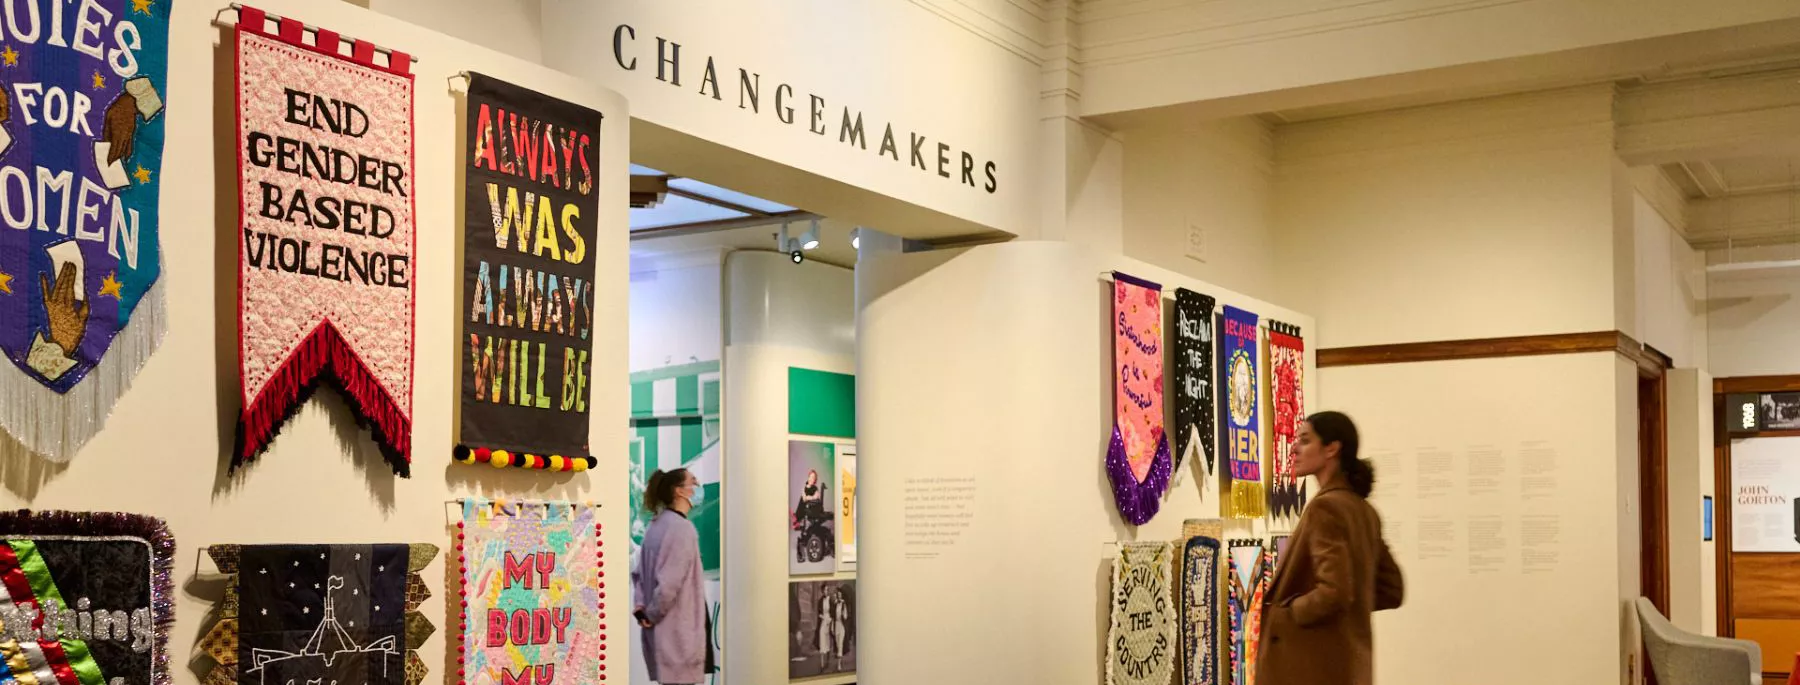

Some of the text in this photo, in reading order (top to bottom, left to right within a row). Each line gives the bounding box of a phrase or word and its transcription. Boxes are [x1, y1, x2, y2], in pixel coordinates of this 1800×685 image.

[0, 0, 142, 78] OTES
[13, 82, 94, 137] FOR
[284, 87, 369, 139] END
[612, 23, 998, 194] CHANGEMAKERS
[247, 131, 407, 197] GENDER
[474, 103, 592, 195] ALWAYS
[0, 165, 139, 270] OMEN
[258, 181, 395, 239] BASED
[485, 182, 586, 265] WAS
[243, 228, 409, 289] VIOLENCE
[471, 260, 591, 340] ALWAYS
[1225, 318, 1257, 341] BECAUSE
[470, 333, 587, 413] WILL BE
[1187, 349, 1203, 369] THE
[1185, 373, 1208, 399] NIGHT
[1742, 403, 1755, 429] 1968
[1229, 427, 1259, 462] HER
[843, 496, 849, 516] 9
[1738, 485, 1769, 495] JOHN
[1738, 495, 1786, 505] GORTON
[503, 551, 555, 590] MY
[1119, 568, 1166, 613] SERVING
[486, 607, 572, 647] BODY
[1129, 611, 1153, 632] THE
[1116, 632, 1168, 679] COUNTRY
